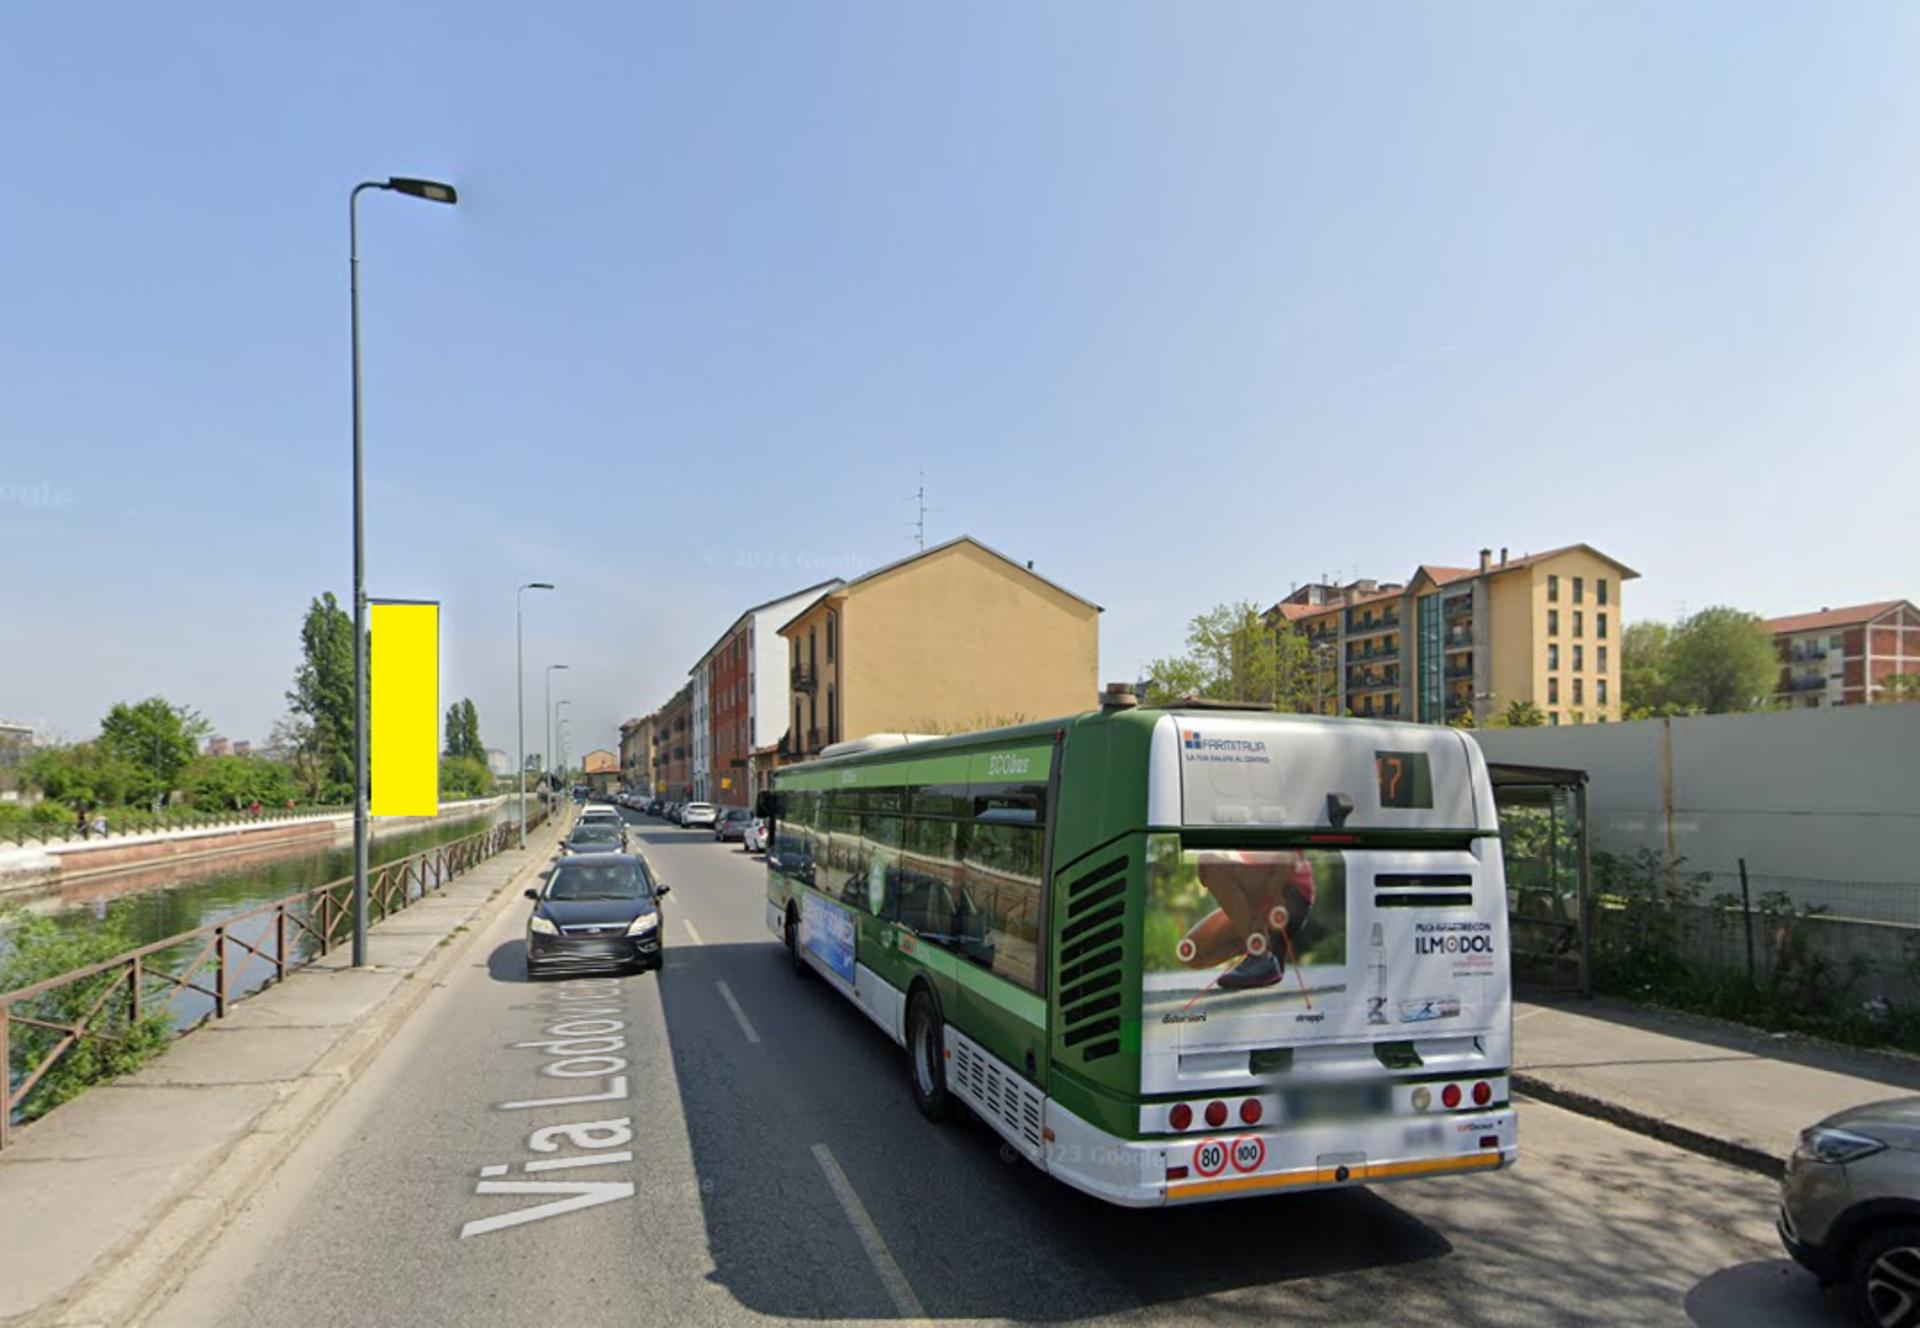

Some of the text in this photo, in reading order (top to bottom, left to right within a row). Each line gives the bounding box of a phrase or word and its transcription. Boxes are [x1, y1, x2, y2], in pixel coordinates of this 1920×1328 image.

[1203, 739, 1266, 752] FARMITALIA
[1415, 935, 1494, 955] ILMODOL
[1202, 1144, 1258, 1168] 80 100
